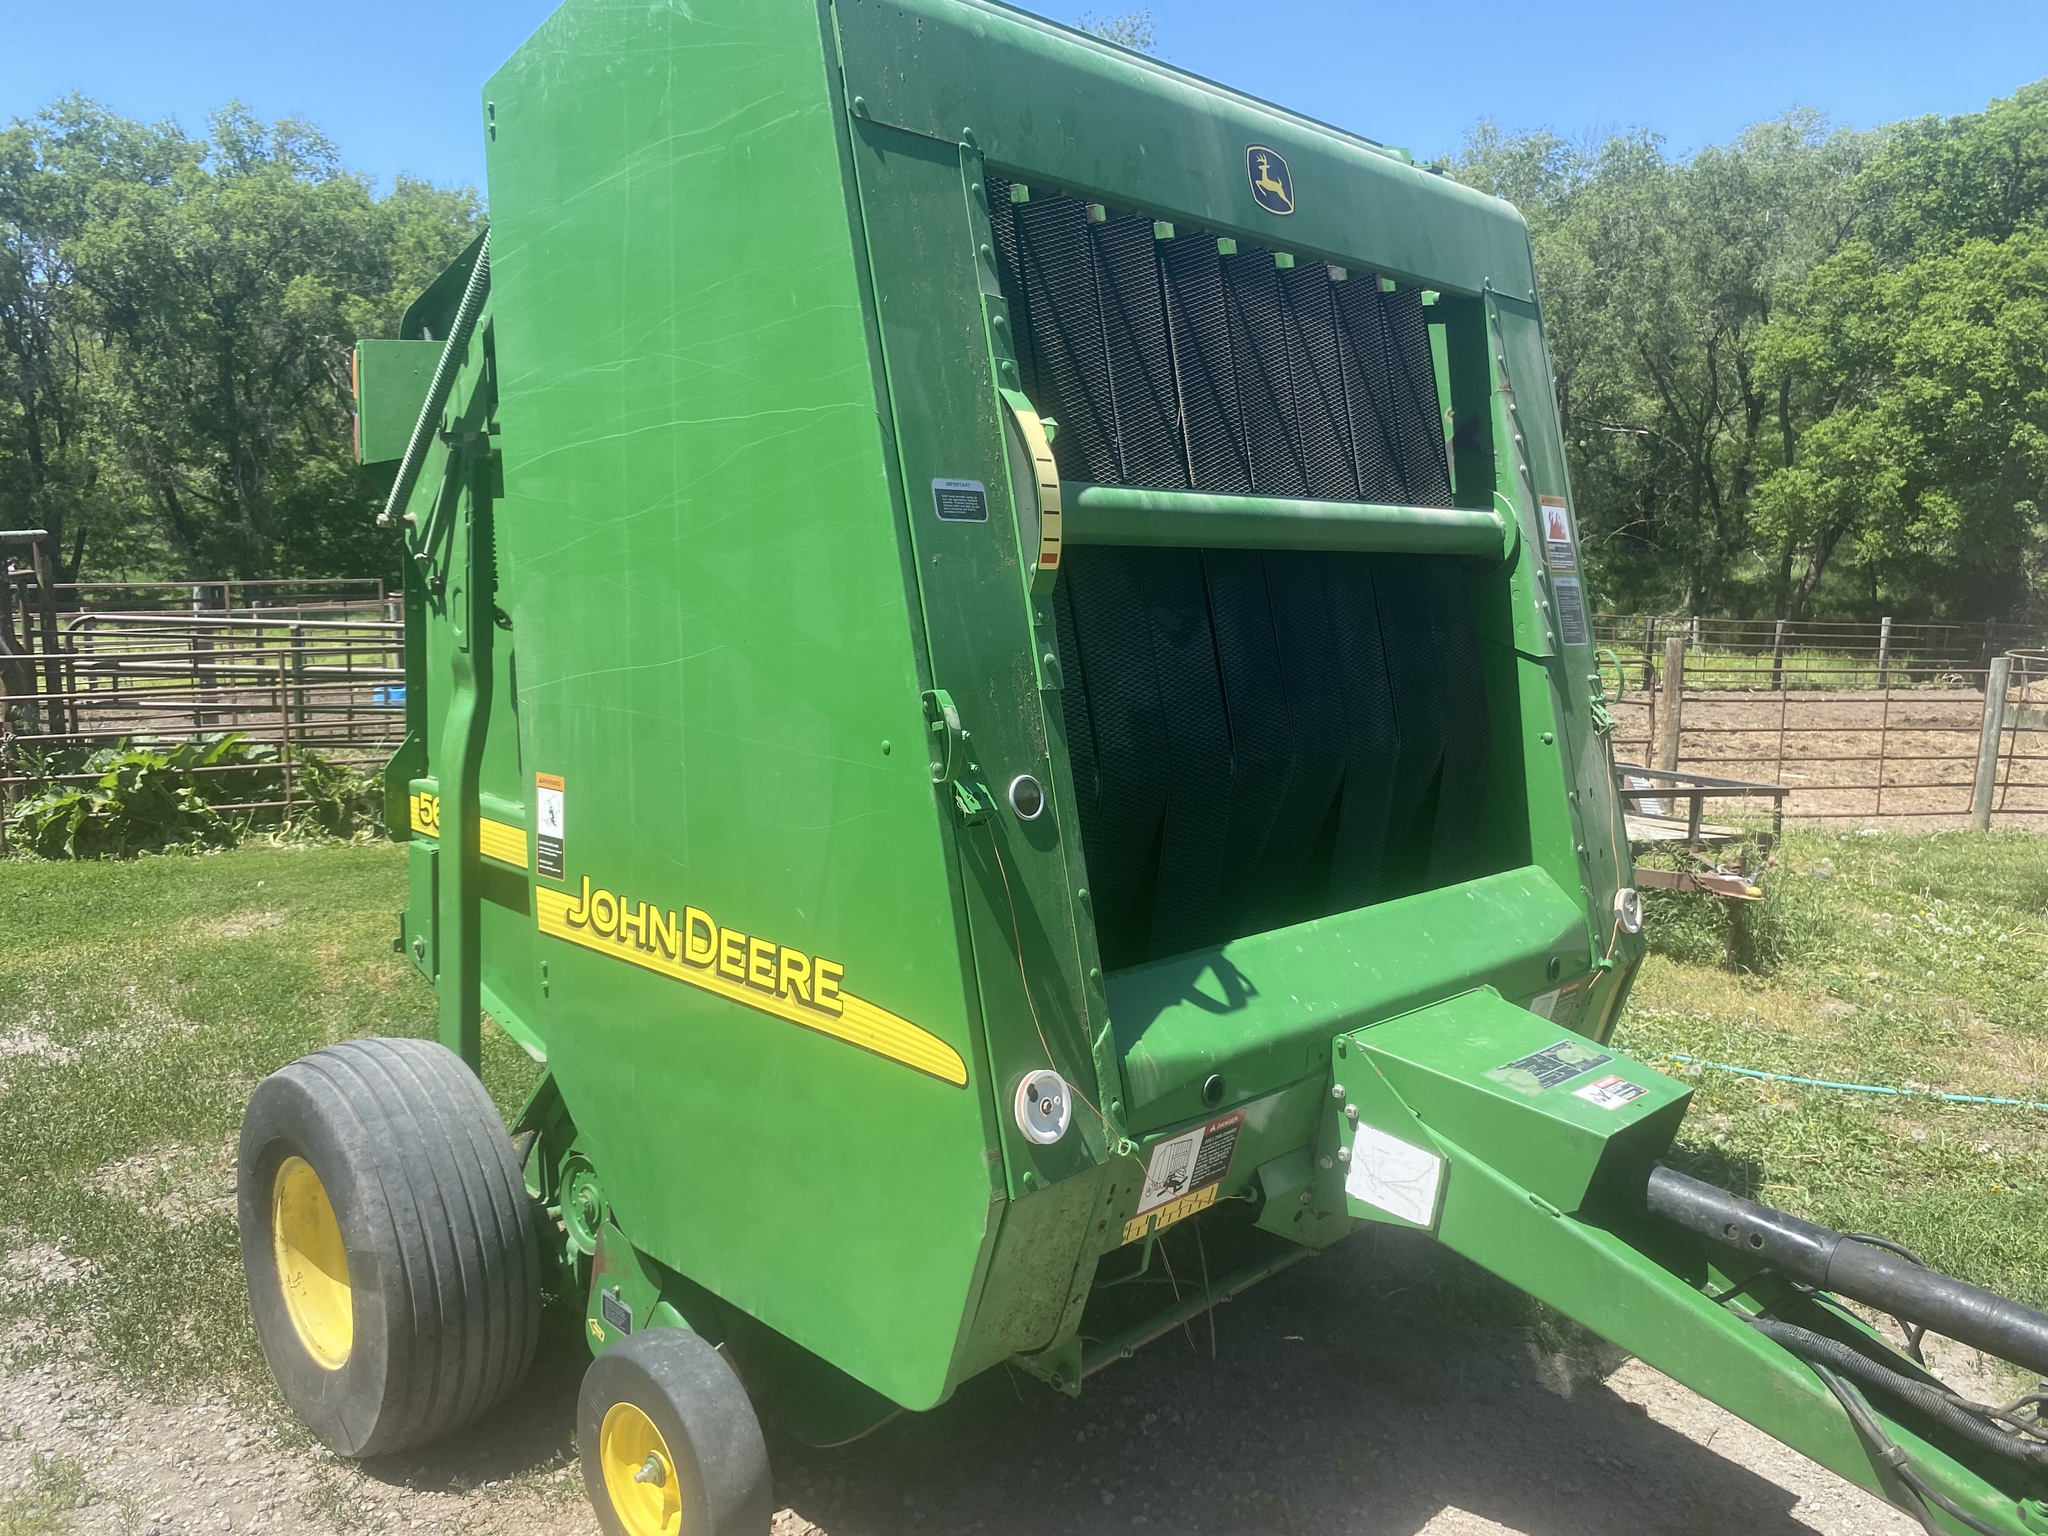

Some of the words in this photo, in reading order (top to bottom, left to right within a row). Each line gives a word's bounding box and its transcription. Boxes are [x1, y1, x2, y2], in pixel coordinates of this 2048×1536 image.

[566, 874, 678, 960] JOHN
[681, 904, 844, 1019] DEERE
[1216, 1116, 1239, 1129] DANGER
